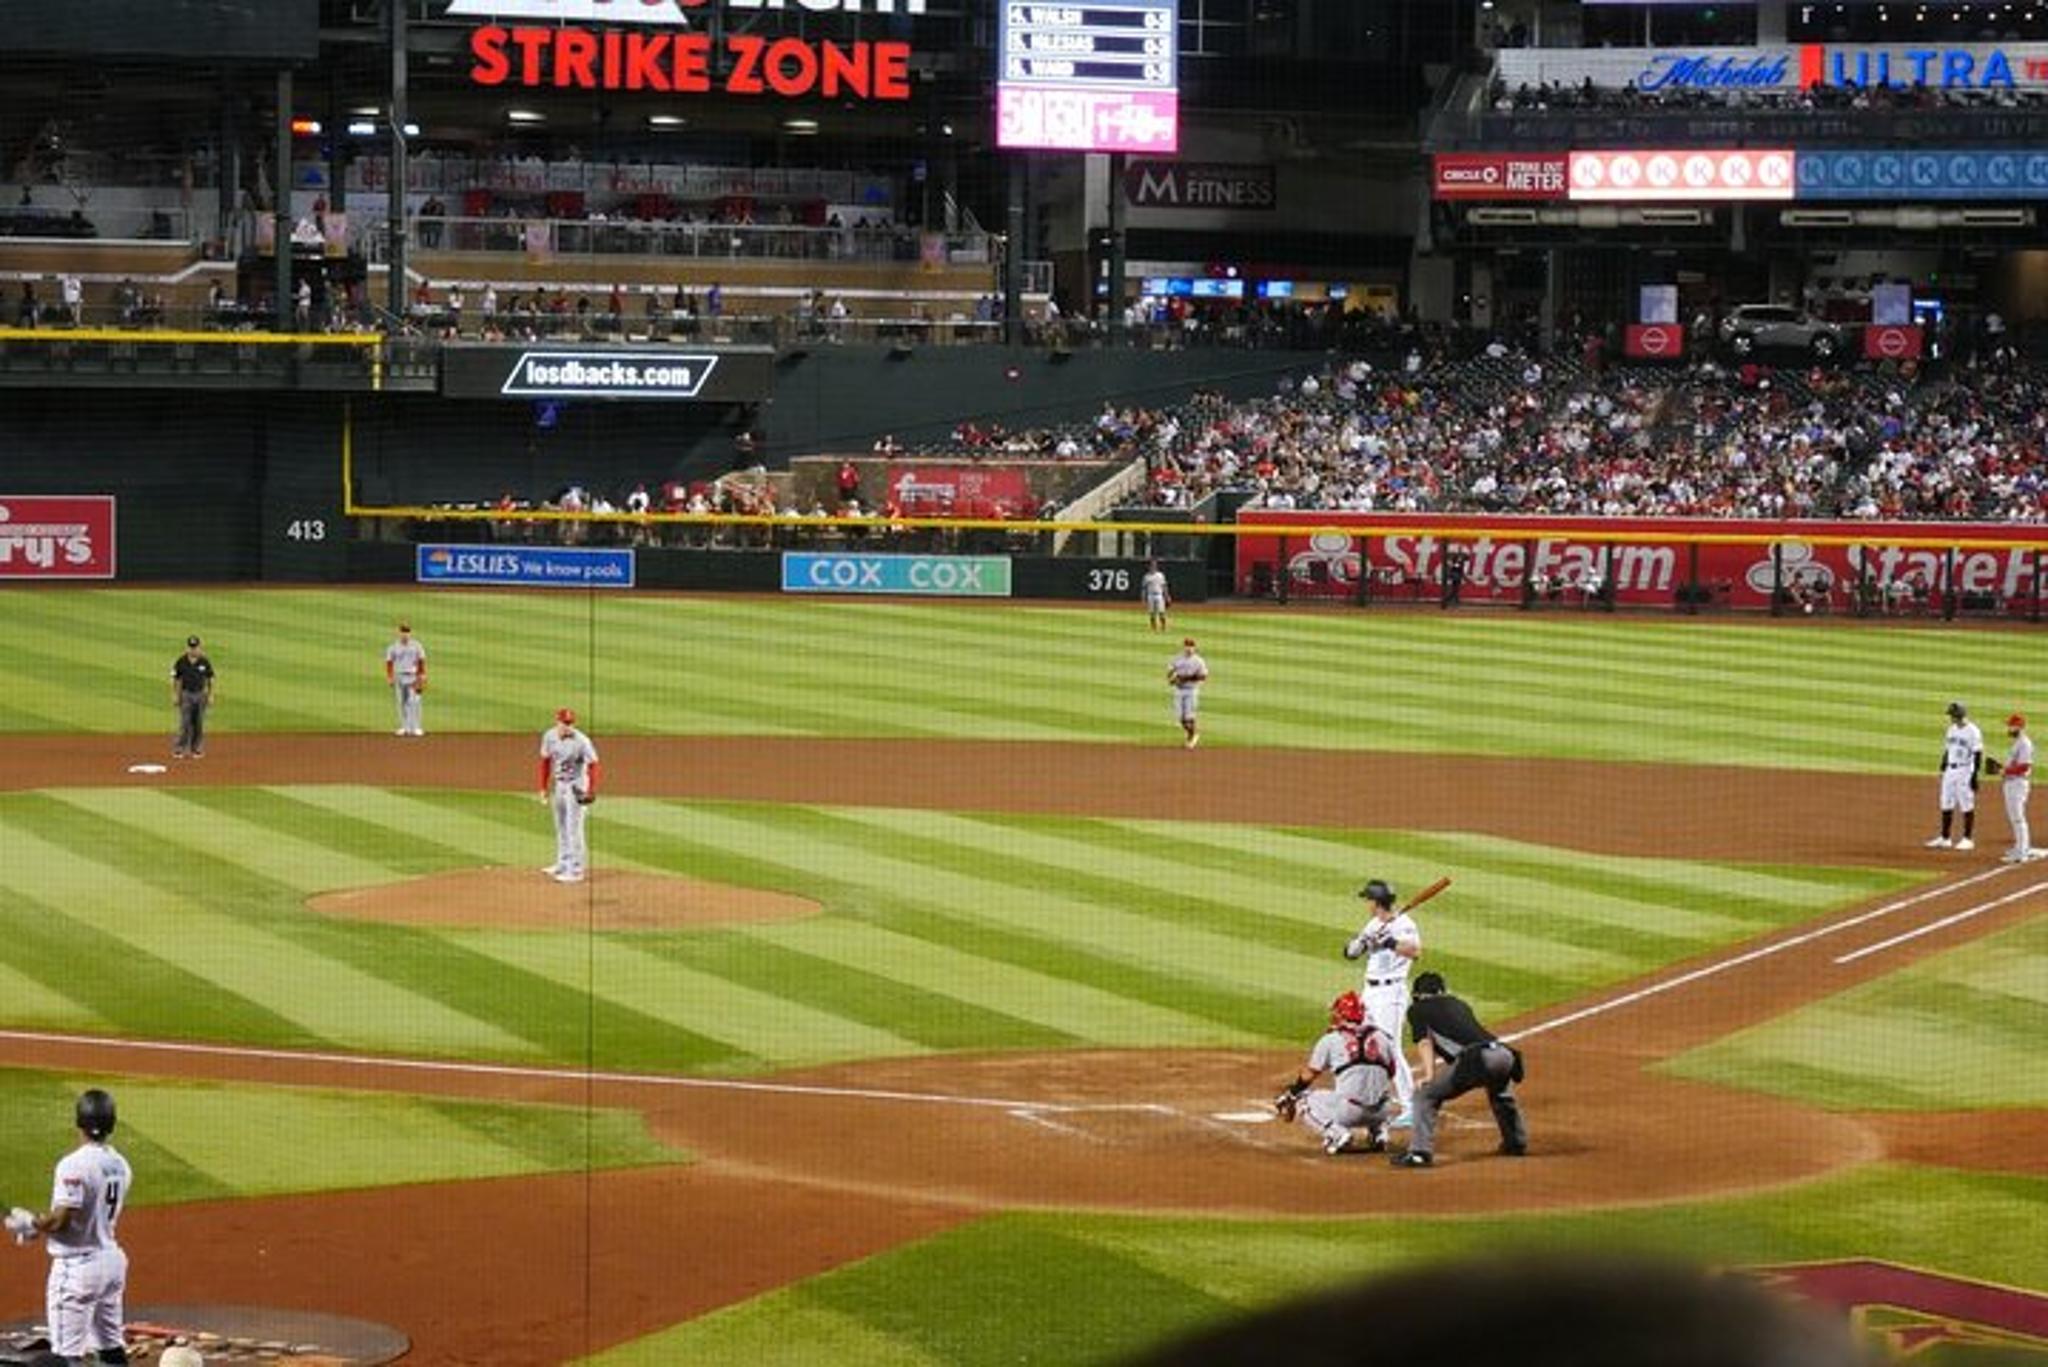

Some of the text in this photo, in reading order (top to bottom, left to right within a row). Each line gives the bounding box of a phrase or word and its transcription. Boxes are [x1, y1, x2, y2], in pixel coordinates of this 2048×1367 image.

[471, 25, 909, 99] STRIKE ZONE
[1639, 56, 1791, 91] Michelob
[1833, 49, 2014, 88] ULTRA
[1187, 180, 1272, 204] FITNESS
[1506, 172, 1564, 192] METER
[526, 361, 691, 386] losdbacks.com
[287, 519, 325, 541] 413
[546, 560, 581, 576] know
[810, 560, 982, 589] COX COX
[1089, 568, 1130, 591] 376
[104, 1181, 119, 1220] 4
